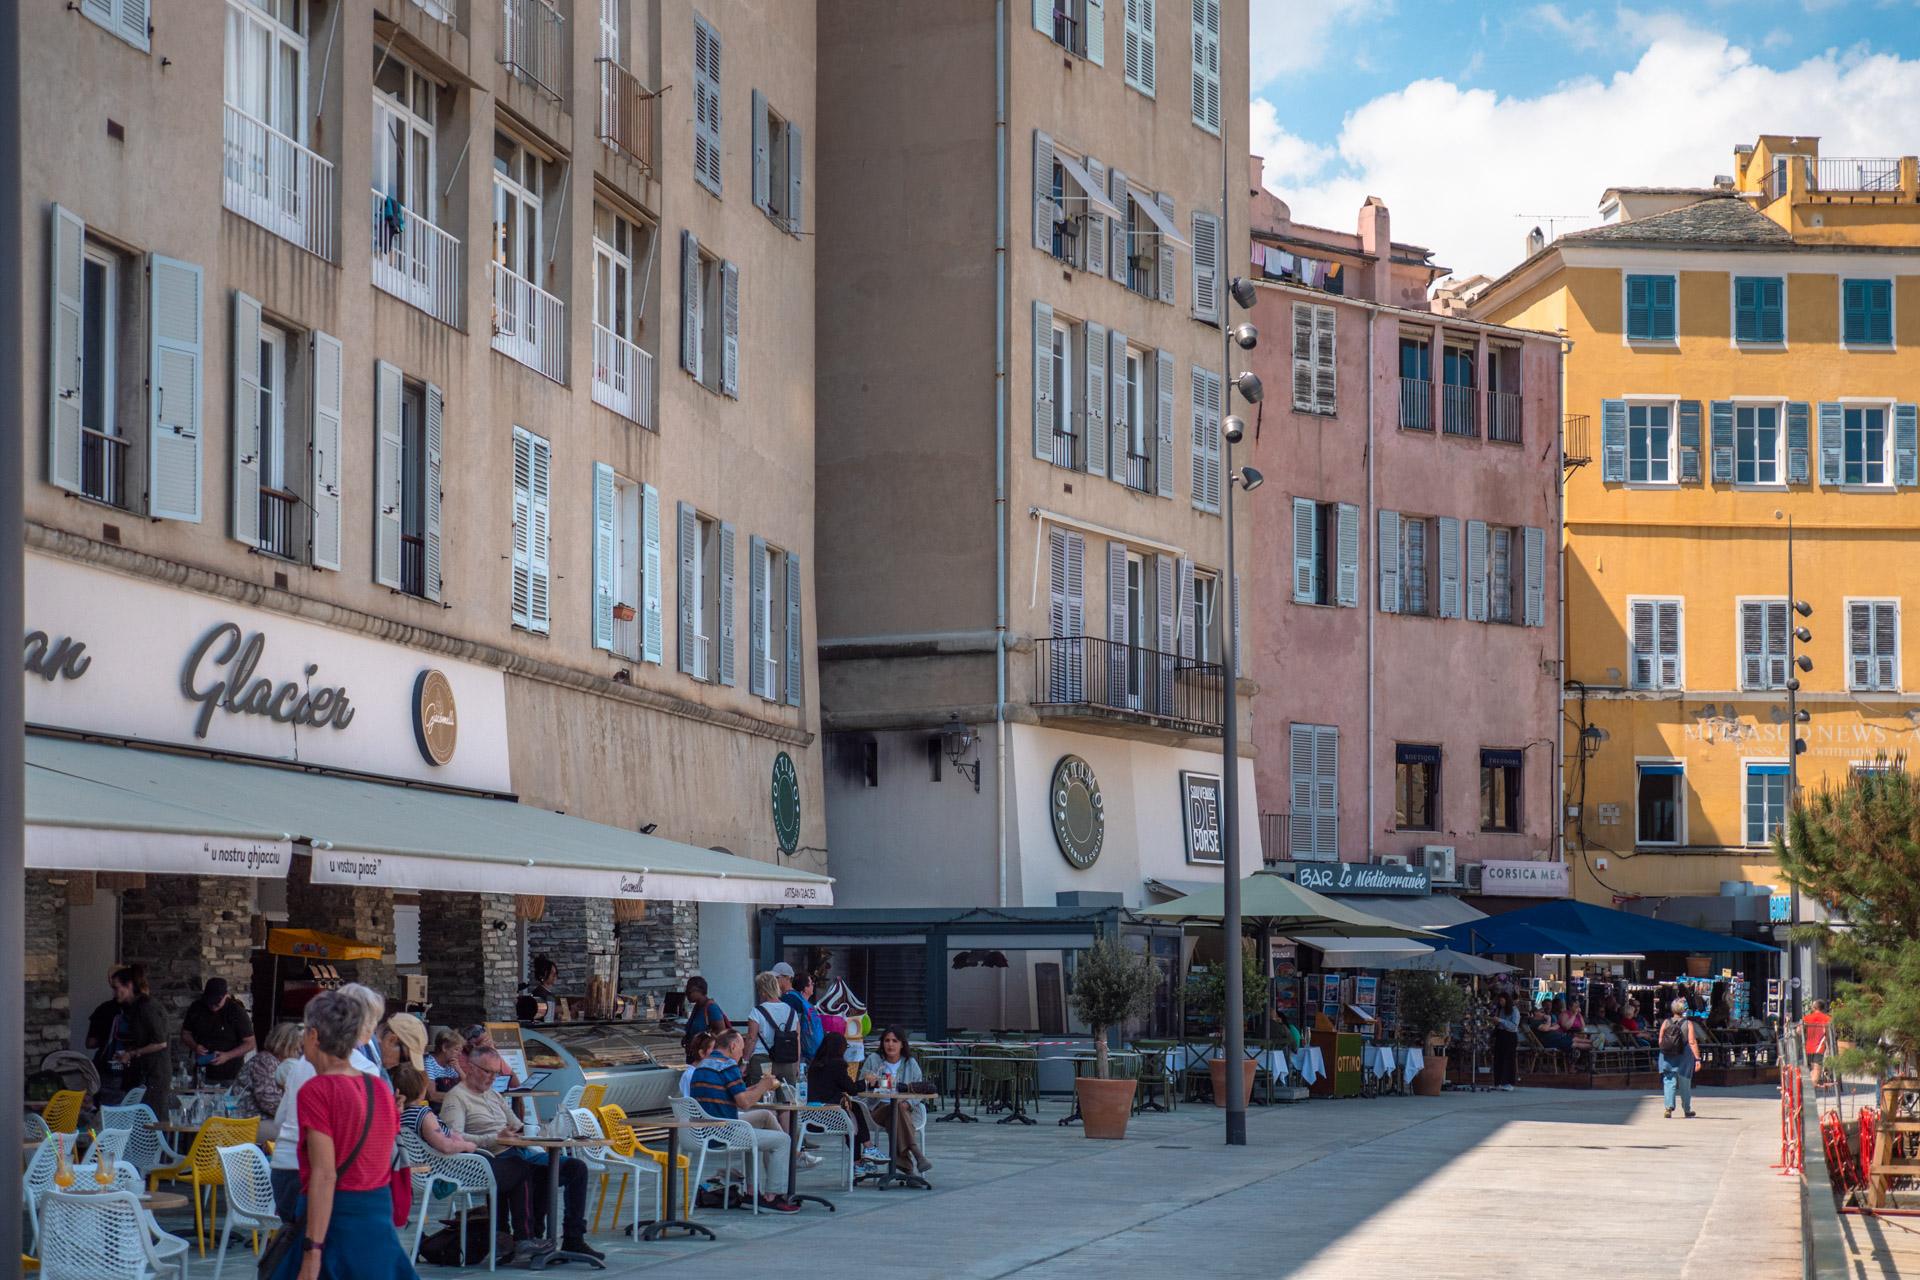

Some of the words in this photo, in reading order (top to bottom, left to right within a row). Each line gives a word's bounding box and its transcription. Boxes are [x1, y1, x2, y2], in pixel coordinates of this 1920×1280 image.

[182, 622, 355, 739] Glacier
[1818, 723, 1887, 744] NEWS
[773, 756, 798, 800] OTTIMO
[1058, 761, 1103, 808] OTTIMO
[1190, 785, 1216, 800] SOUVENIRS
[1190, 797, 1218, 831] DE
[1193, 829, 1220, 853] CORSE
[218, 848, 246, 862] nostru
[247, 846, 281, 870] ghjacciu
[336, 860, 357, 874] vostru
[1300, 868, 1334, 888] BAR
[1337, 869, 1352, 889] Le
[1354, 871, 1427, 890] Méditerranée
[1488, 867, 1537, 881] CORSICA
[1540, 868, 1564, 882] MEA
[1337, 1055, 1361, 1073] OTTIMO
